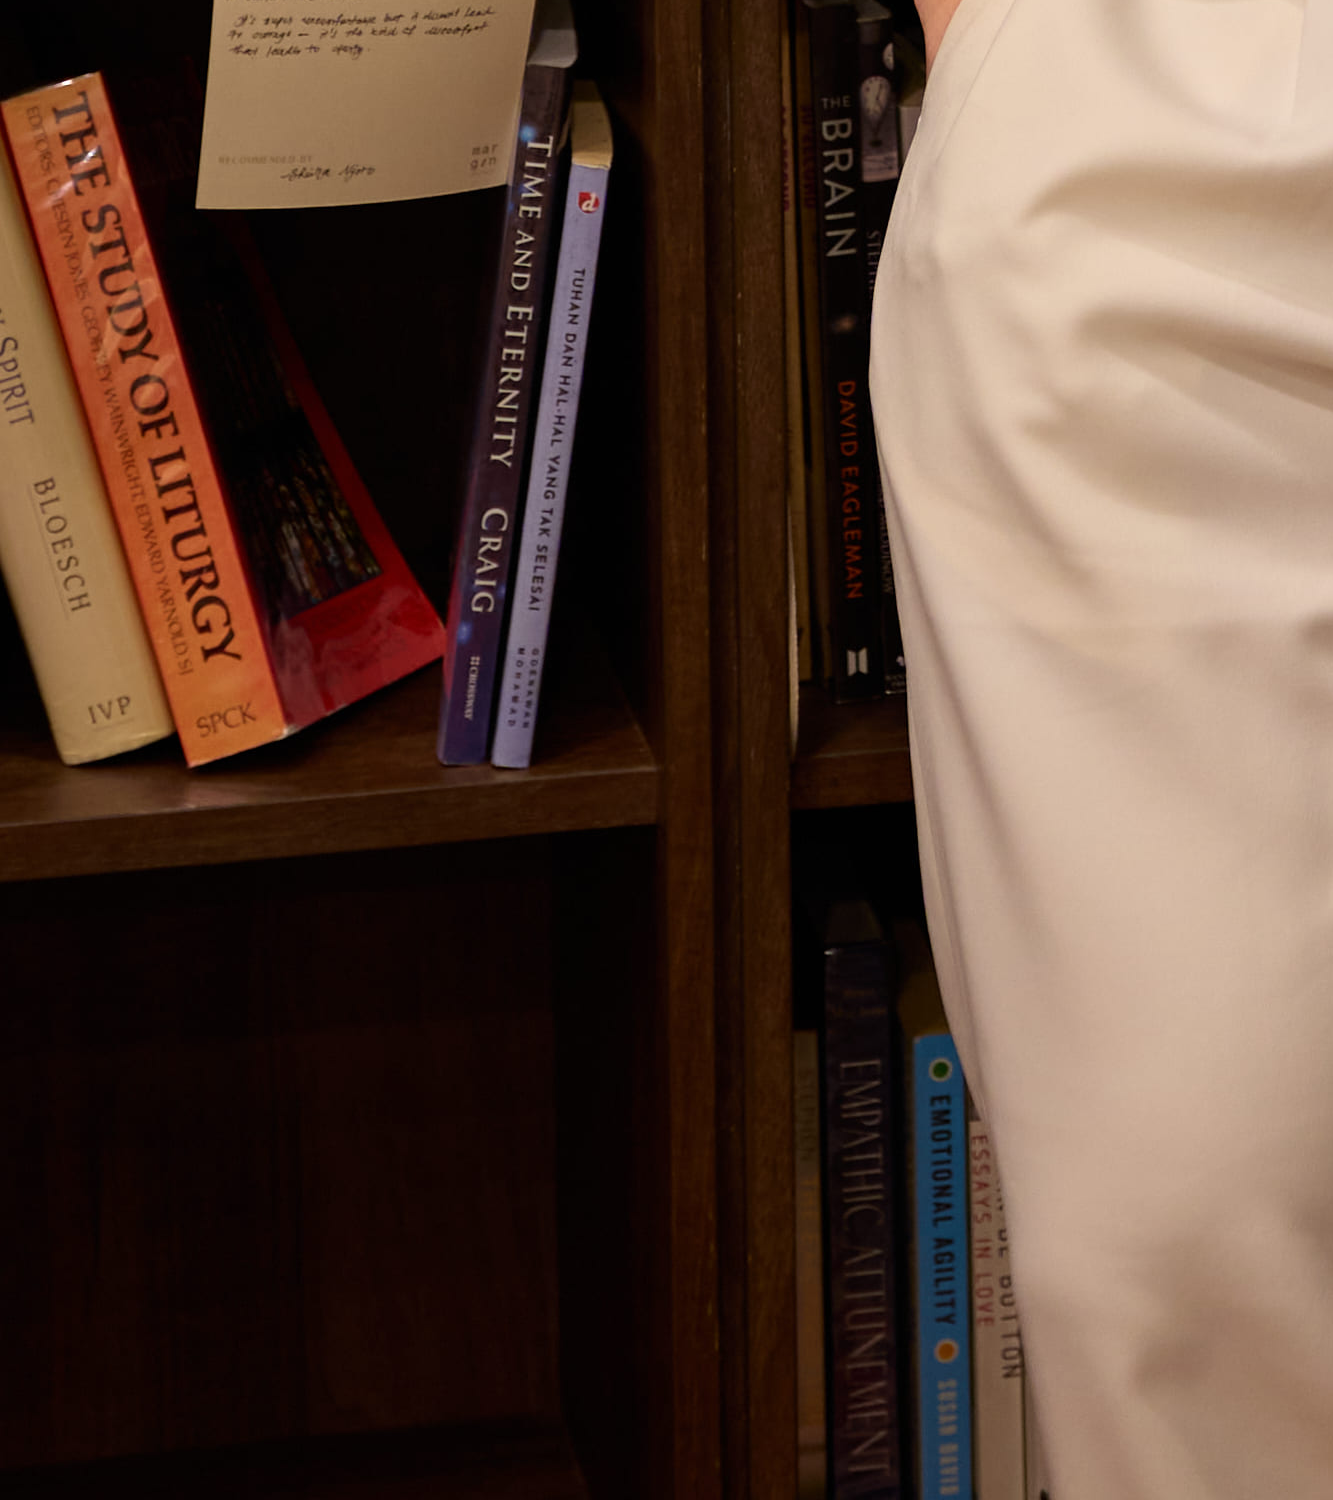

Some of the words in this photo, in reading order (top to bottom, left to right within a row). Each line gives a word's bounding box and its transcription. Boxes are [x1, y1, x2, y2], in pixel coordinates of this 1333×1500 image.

[53, 91, 104, 192] THE
[518, 135, 555, 218] TIME
[820, 119, 856, 259] BRAIN
[93, 205, 158, 365] STUDY
[509, 230, 538, 289] AND
[132, 373, 178, 438] OF
[490, 304, 533, 466] ETERNITY
[836, 380, 857, 457] DAVID
[150, 445, 242, 662] LITURGY
[470, 506, 509, 612] CRAIG
[839, 467, 863, 599] EAGLEMAN
[930, 1095, 952, 1226] EMOTIONAL
[933, 1237, 955, 1326] AGILITY
